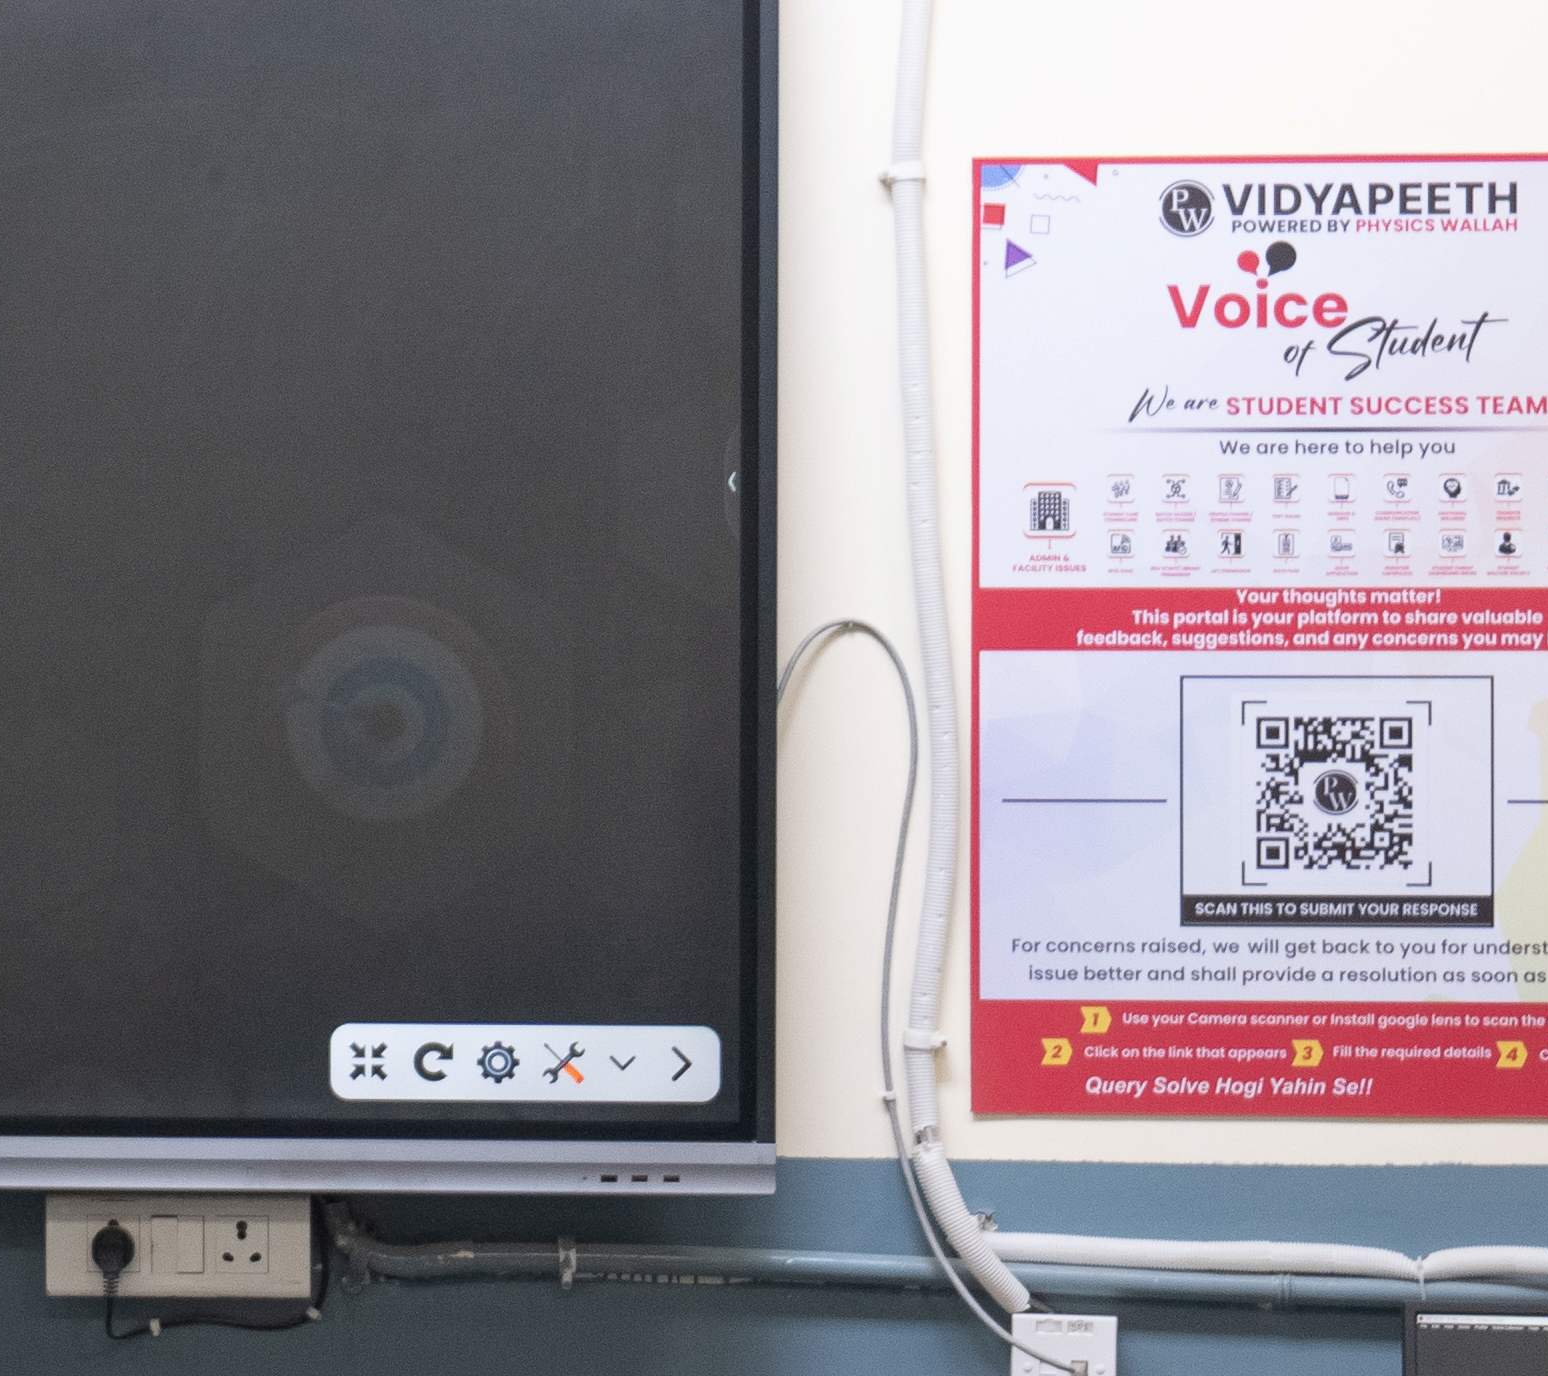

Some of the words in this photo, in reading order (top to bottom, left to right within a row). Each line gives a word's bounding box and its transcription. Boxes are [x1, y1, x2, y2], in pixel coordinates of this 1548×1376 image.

[1223, 182, 1517, 216] VIDYAPEETH
[1232, 220, 1322, 233] POWERED
[1328, 220, 1350, 232] BY
[1356, 218, 1434, 232] PHYSICS
[1441, 218, 1517, 232] WALLAH
[1167, 279, 1348, 329] Voice
[1283, 339, 1318, 376] of
[1327, 312, 1508, 381] Student
[1129, 387, 1178, 422] We
[1184, 396, 1220, 411] are
[1227, 397, 1342, 415] STUDENT
[1350, 396, 1468, 415] SUCCESS
[1477, 396, 1547, 414] TEAM
[1220, 440, 1250, 454] We
[1256, 443, 1288, 454] are
[1295, 440, 1338, 454] here
[1345, 440, 1364, 454] to
[1370, 440, 1412, 459] help
[1419, 442, 1455, 459] you
[1236, 590, 1279, 604] Your
[1282, 590, 1366, 607] thoughts
[1371, 590, 1440, 604] matter!
[1132, 608, 1169, 625] This
[1174, 609, 1228, 629] portal
[1233, 609, 1248, 624] is
[1252, 612, 1294, 629] your
[1298, 608, 1378, 629] platform
[1382, 610, 1401, 624] to
[1405, 610, 1458, 625] share
[1462, 609, 1543, 624] valuable
[1077, 630, 1167, 647] feedback,
[1172, 628, 1288, 650] suggestions,
[1293, 628, 1329, 646] and
[1333, 634, 1368, 650] any
[1372, 633, 1458, 646] concerns
[1462, 633, 1496, 650] you
[1501, 633, 1544, 650] may
[1195, 902, 1237, 916] SCAN
[1241, 902, 1272, 916] THIS
[1276, 902, 1296, 916] TO
[1300, 902, 1354, 916] SUBMIT
[1358, 903, 1399, 916] YOUR
[1402, 903, 1478, 916] RESPONSE
[1012, 939, 1040, 952] For
[1046, 941, 1135, 953] concerns
[1142, 938, 1206, 955] raised,
[1213, 942, 1239, 953] we
[1248, 938, 1278, 954] will
[1285, 940, 1316, 959] get
[1322, 939, 1369, 954] back
[1376, 940, 1394, 954] to
[1400, 943, 1435, 959] you
[1442, 939, 1467, 954] for
[1029, 965, 1078, 981] issue
[1084, 966, 1142, 981] better
[1148, 966, 1184, 981] and
[1192, 967, 1236, 981] shall
[1242, 966, 1316, 986] provide
[1322, 970, 1333, 981] a
[1340, 966, 1436, 982] resolution
[1443, 971, 1465, 983] as
[1472, 971, 1518, 983] soon
[1524, 971, 1546, 983] as
[1051, 1045, 1063, 1059] 2
[1084, 1045, 1118, 1058] Click
[1122, 1048, 1140, 1058] on
[1142, 1046, 1165, 1058] the
[1168, 1045, 1193, 1058] link
[1196, 1046, 1225, 1058] that
[1228, 1049, 1286, 1062] appears
[1302, 1046, 1313, 1060] 3
[1333, 1045, 1352, 1058] Fill
[1355, 1046, 1378, 1058] the
[1381, 1045, 1440, 1061] required
[1444, 1046, 1492, 1058] details
[1505, 1048, 1518, 1061] 4
[1086, 1076, 1148, 1098] Query
[1153, 1077, 1210, 1094] Solve
[1215, 1077, 1264, 1098] Hogi
[1270, 1078, 1326, 1095] Yahin
